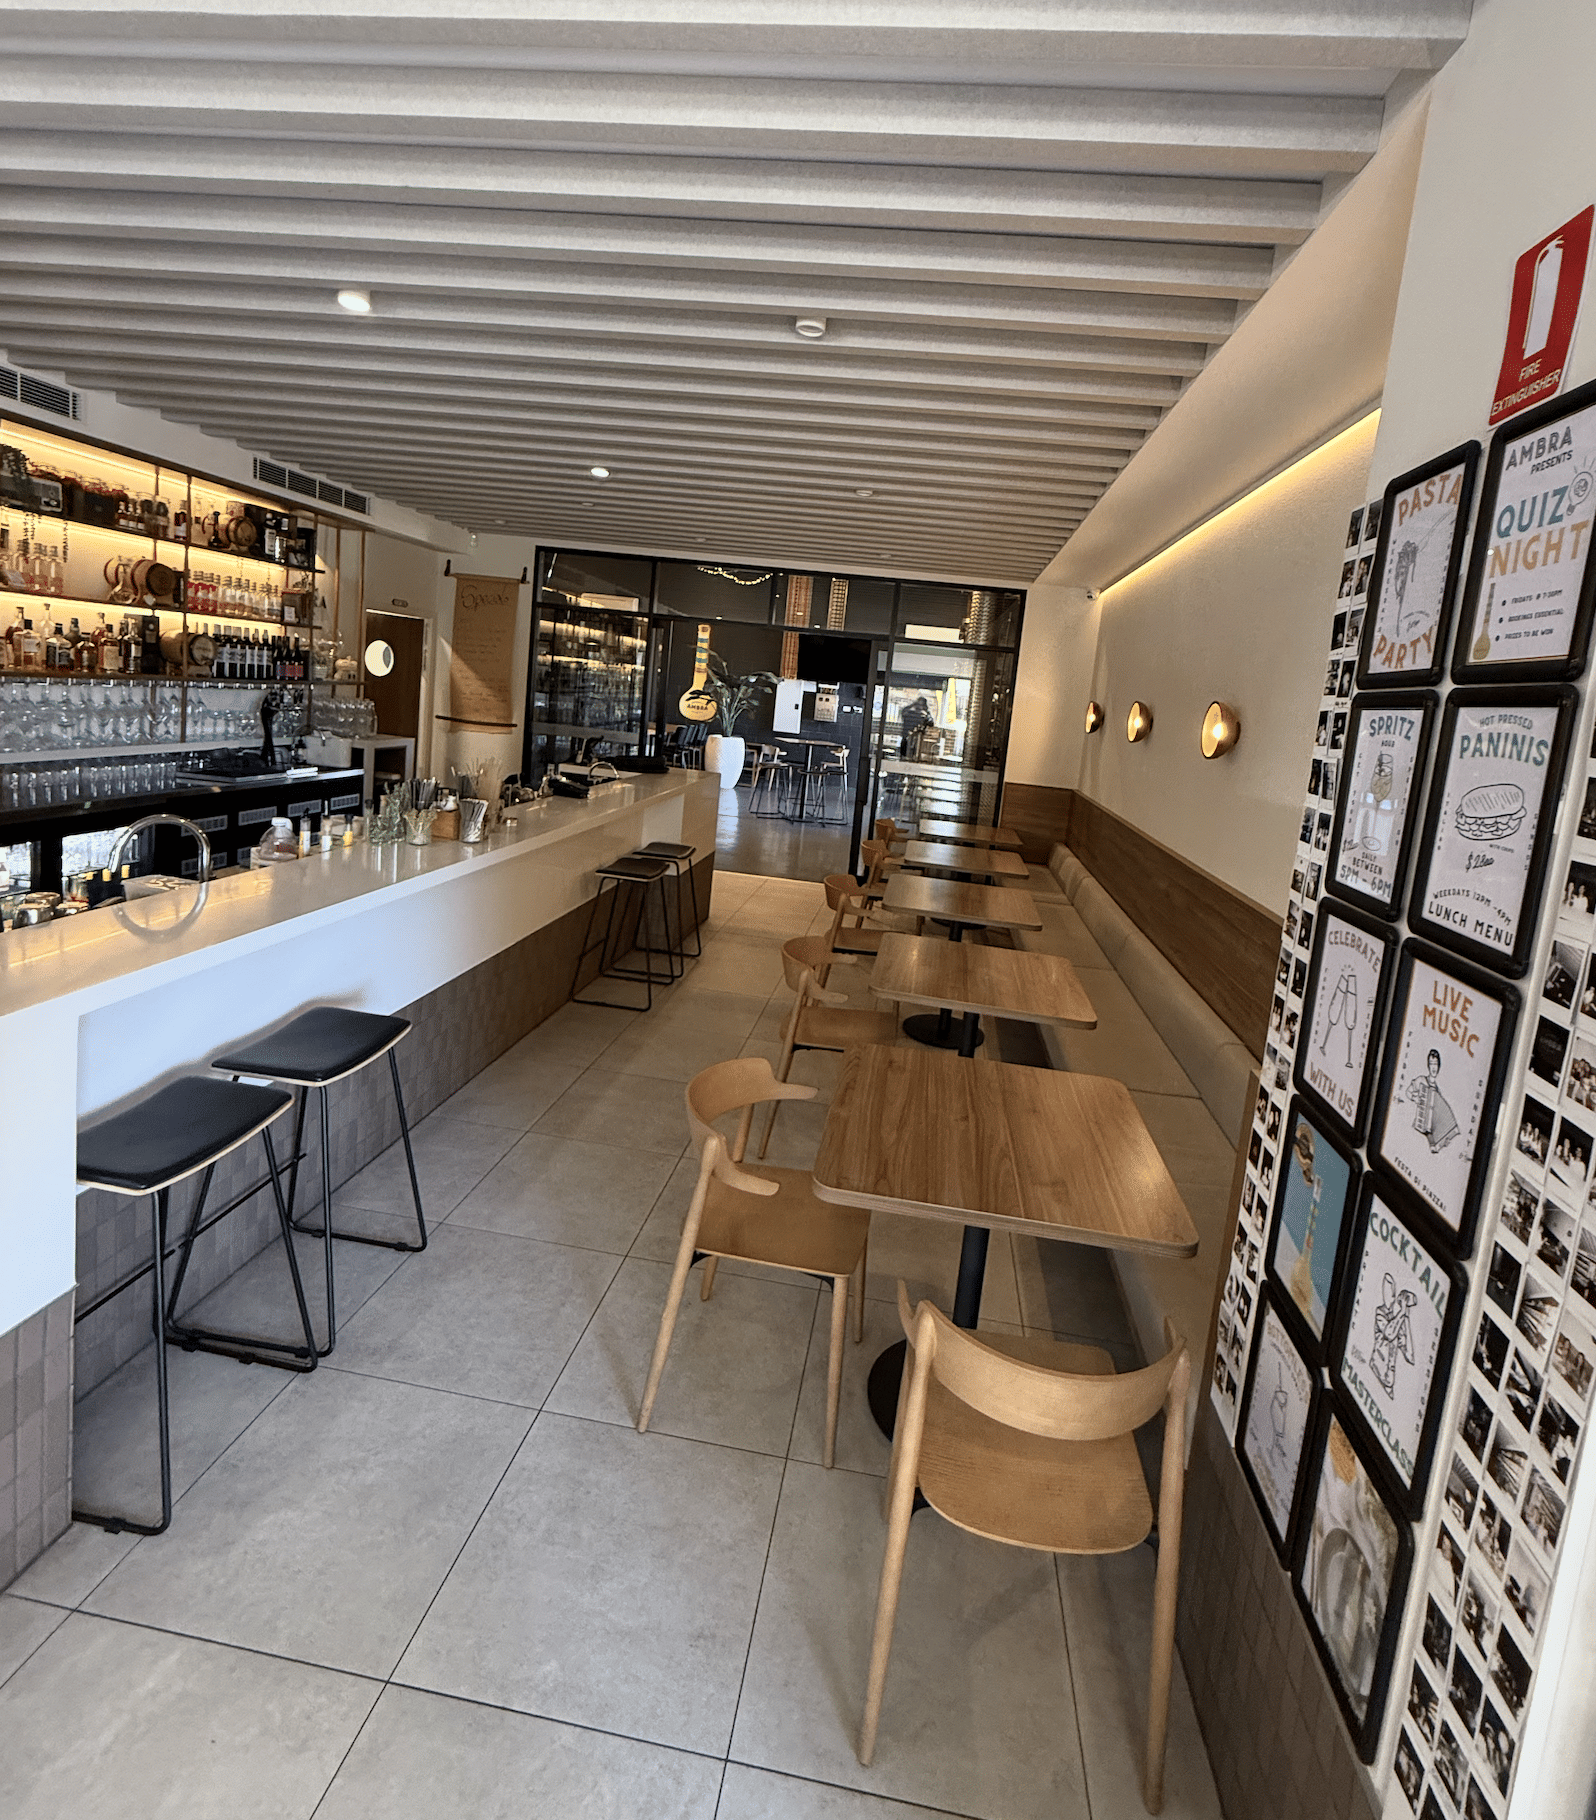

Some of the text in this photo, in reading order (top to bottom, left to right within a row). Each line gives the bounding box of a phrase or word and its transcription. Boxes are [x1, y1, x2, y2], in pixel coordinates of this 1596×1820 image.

[1518, 358, 1542, 382] FIRE
[1491, 368, 1562, 416] EXTINGUISHER
[1505, 426, 1573, 471] AMBRA
[1530, 450, 1573, 474] PRESENTS
[1398, 473, 1463, 527] PASTA
[1496, 485, 1569, 538] QUIZ
[1489, 519, 1590, 578] NIGHT
[1373, 624, 1436, 669] PARTY
[1540, 628, 1554, 636] WON
[1369, 715, 1415, 741] SPRITZ
[1479, 714, 1534, 730] HOT PRESSED
[1459, 732, 1549, 767] PANINIS
[1352, 857, 1383, 876] BETWEEN
[1362, 851, 1377, 862] DAILY
[1340, 864, 1359, 885] 5PM
[1370, 876, 1392, 898] 6PM
[1433, 889, 1470, 900] WEEKDAYS
[1472, 890, 1492, 907] 12PM
[1428, 901, 1514, 947] LUNCH MENU
[1328, 930, 1382, 972] CELEBRATE
[1432, 980, 1474, 1022] LIVE
[1422, 1004, 1480, 1058] MUSIC
[1309, 1061, 1354, 1118] WITH US
[1467, 1080, 1483, 1147] SUNDAY
[1394, 1156, 1412, 1178] FESTA
[1413, 1176, 1422, 1187] DI
[1370, 1212, 1447, 1319] COCKTAIL
[1352, 1250, 1369, 1330] PRIVATE
[1341, 1356, 1415, 1478] MASTERCLASS
